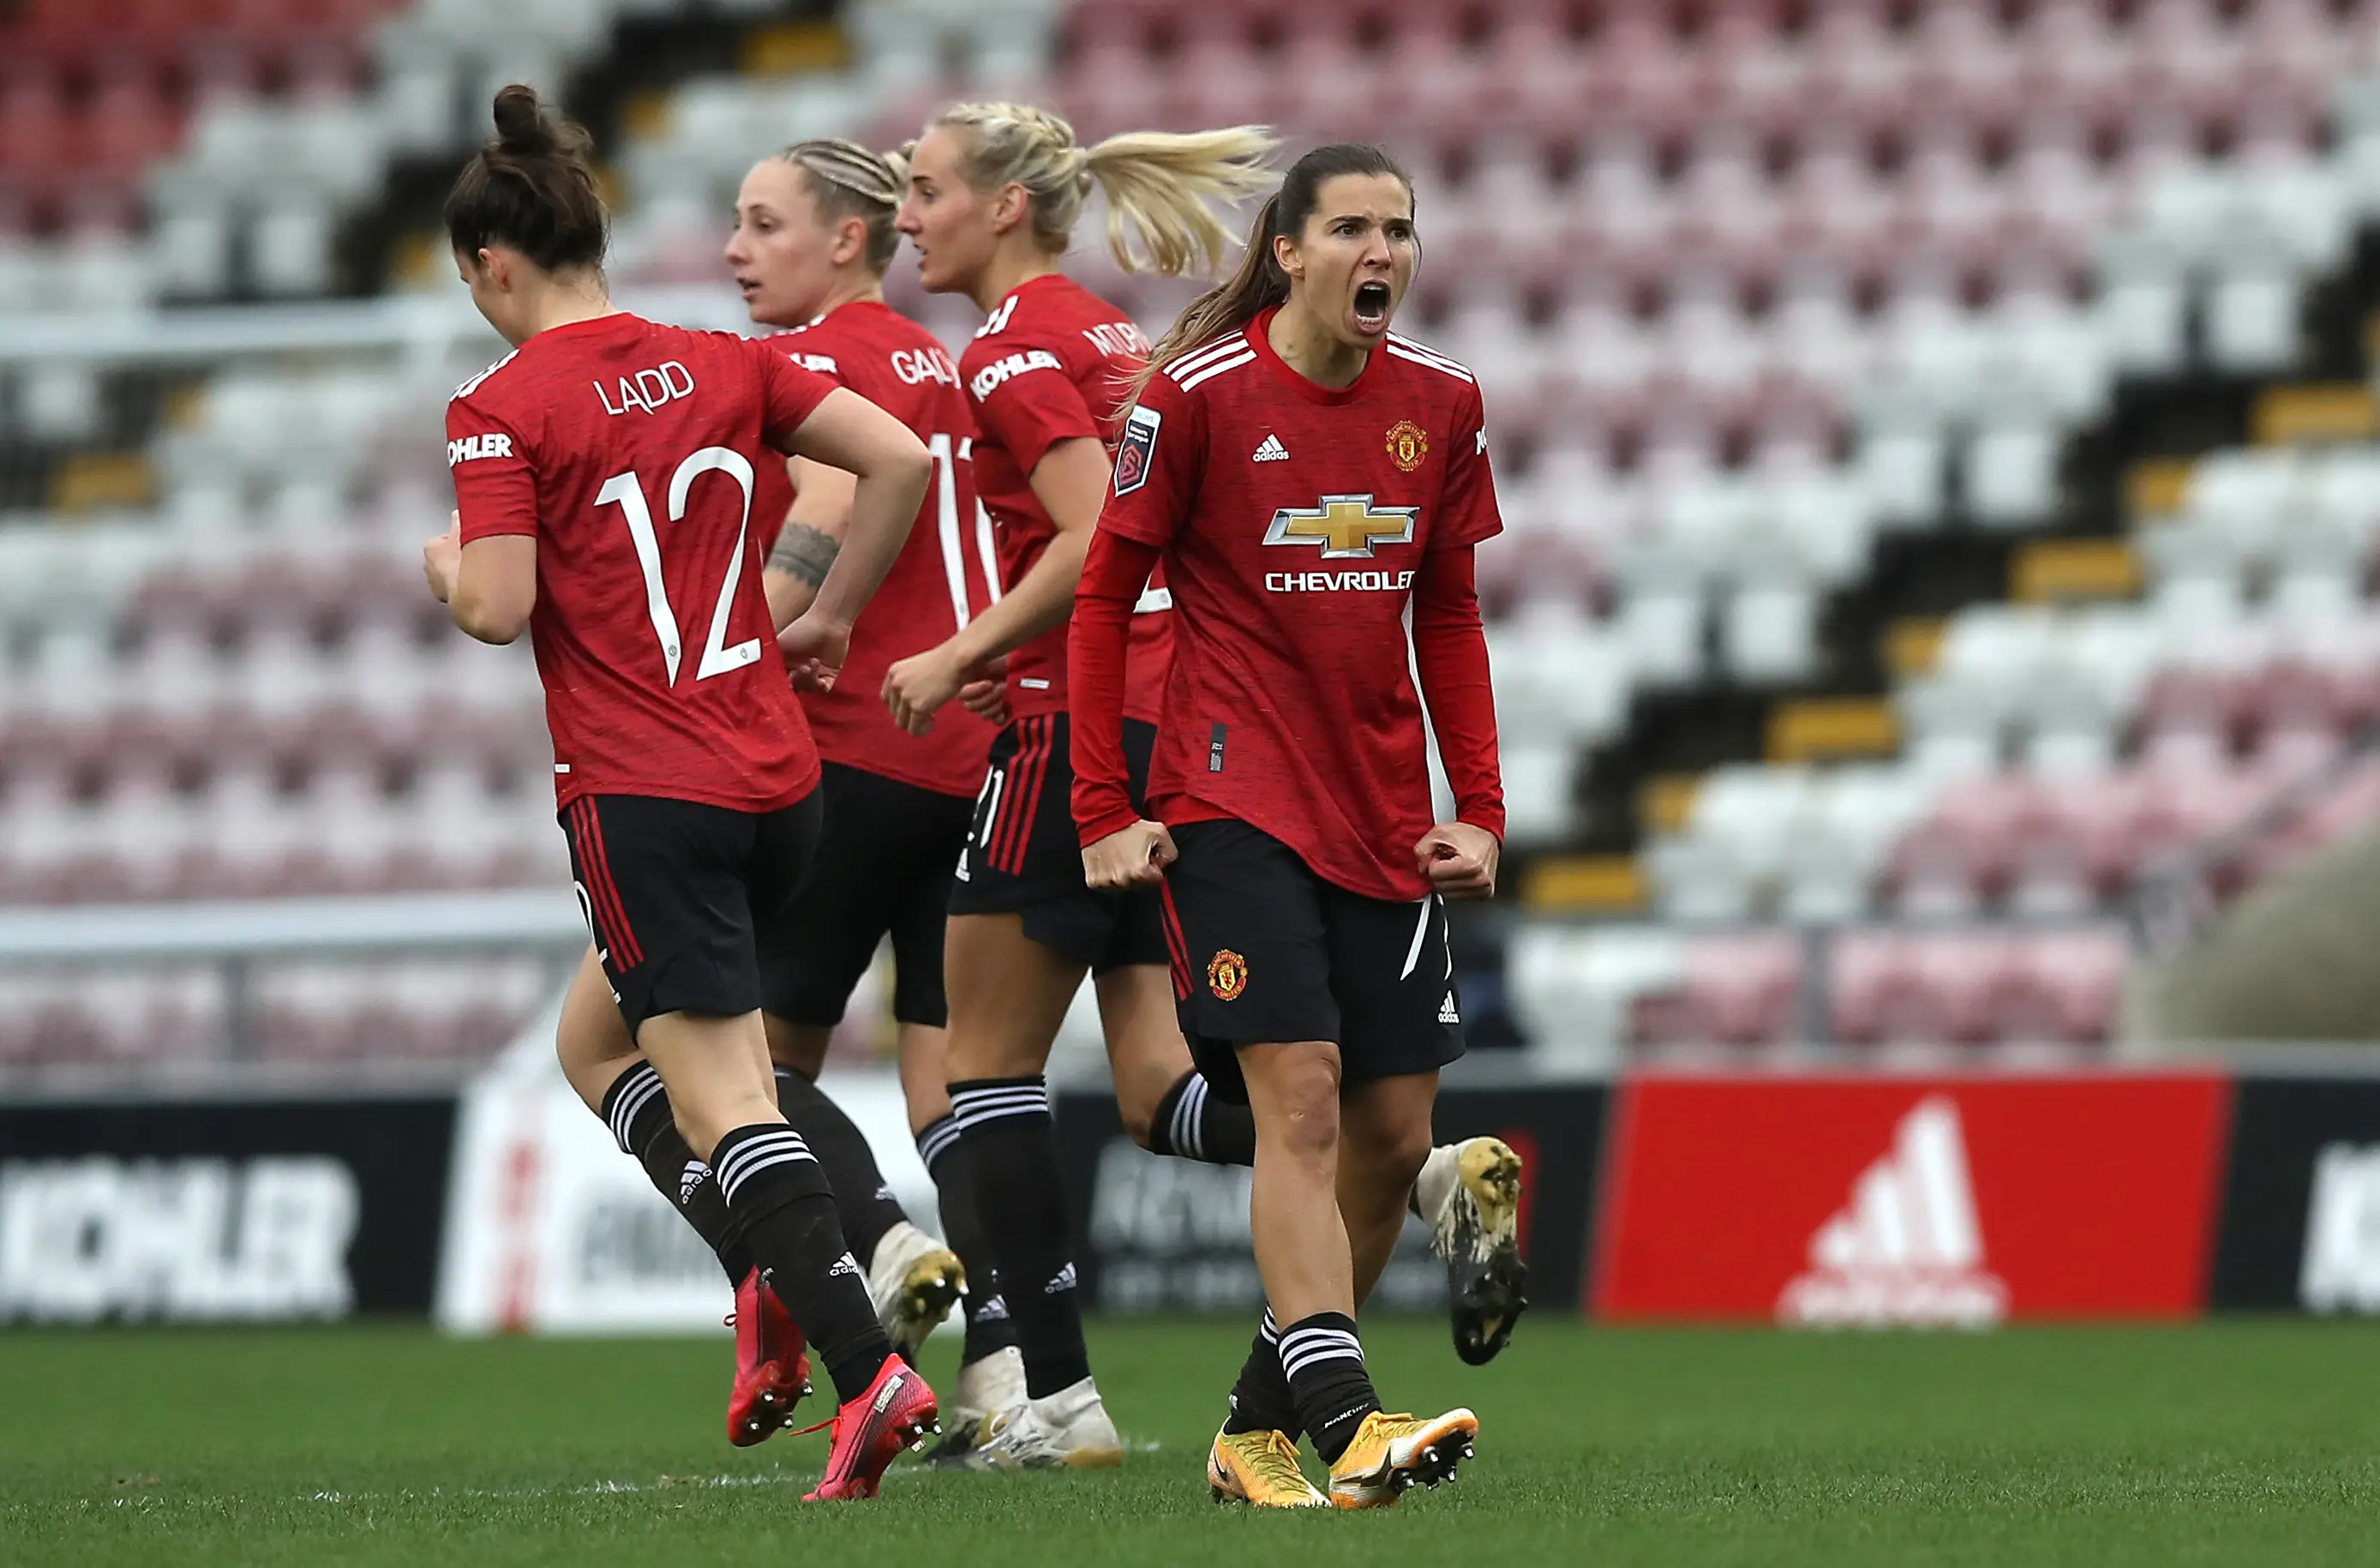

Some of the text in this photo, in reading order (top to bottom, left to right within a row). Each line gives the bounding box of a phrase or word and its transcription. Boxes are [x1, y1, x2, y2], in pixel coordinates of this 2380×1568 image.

[593, 361, 695, 416] LADD
[969, 350, 1063, 404] KOHLER
[1252, 450, 1290, 462] adidas
[593, 447, 762, 688] 12
[1265, 570, 1416, 592] CHEVROLET
